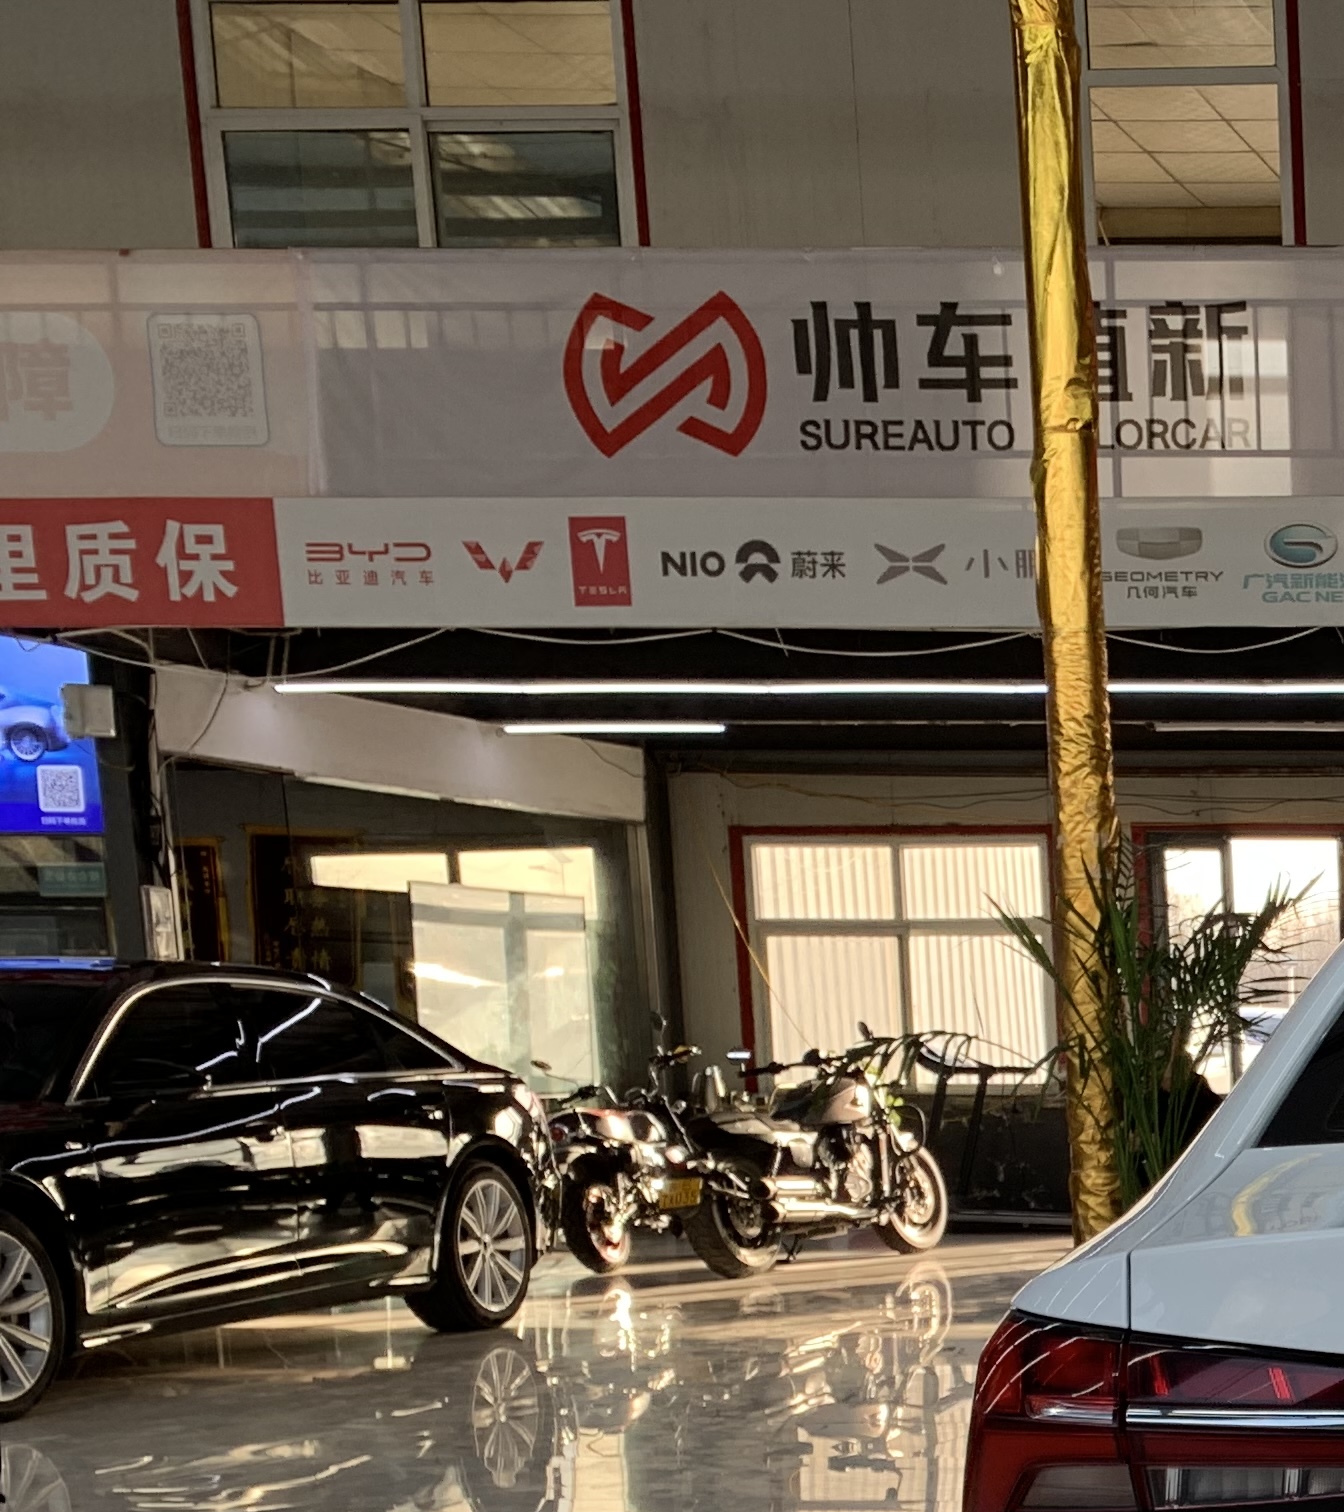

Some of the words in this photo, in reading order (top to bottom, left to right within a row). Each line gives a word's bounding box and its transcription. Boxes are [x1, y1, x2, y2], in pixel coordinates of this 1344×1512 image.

[800, 418, 1015, 451] SUREAUTO
[305, 542, 433, 563] BYD
[660, 550, 726, 577] NIO
[790, 550, 847, 580] 蔚来
[307, 569, 435, 586] 比亚迪汽车
[1101, 571, 1224, 582] GEOMETRY
[578, 585, 628, 595] TESLA
[1127, 586, 1198, 599] 几何汽车
[1261, 591, 1312, 603] GAC
